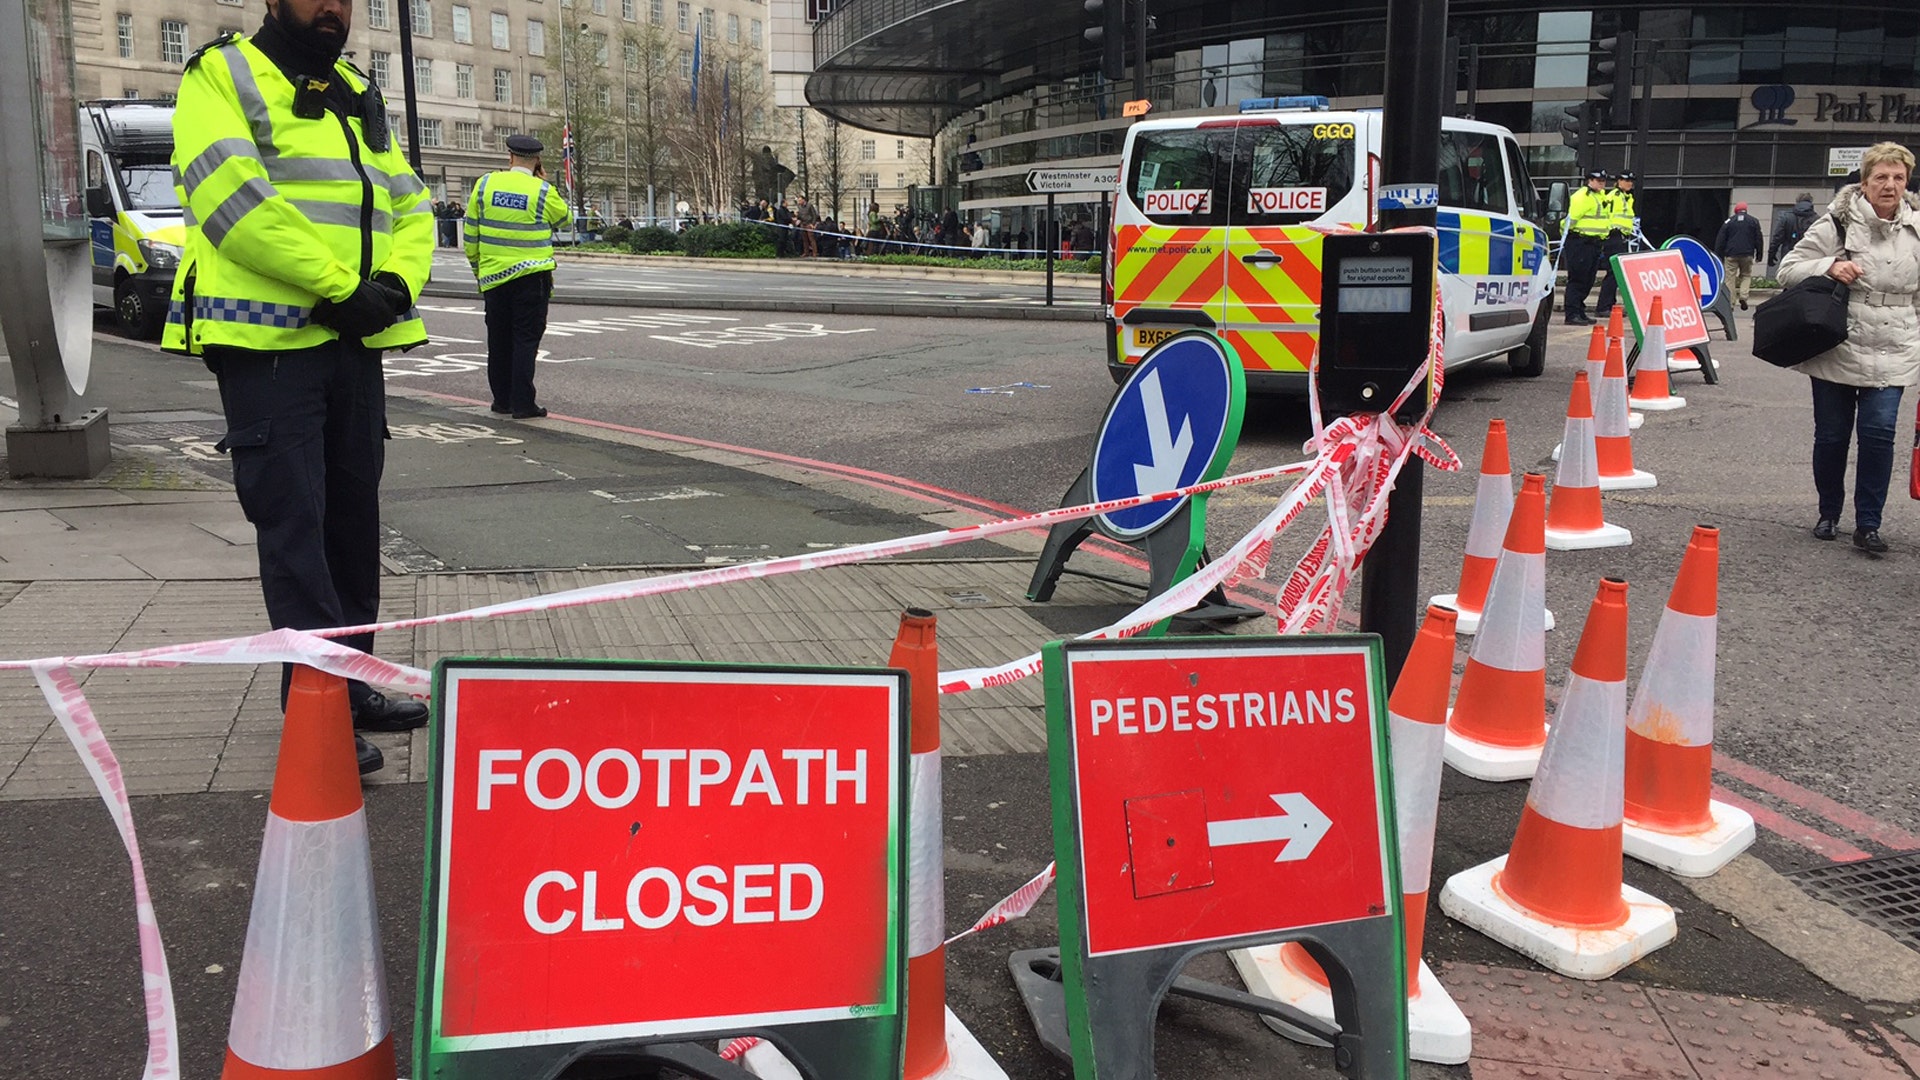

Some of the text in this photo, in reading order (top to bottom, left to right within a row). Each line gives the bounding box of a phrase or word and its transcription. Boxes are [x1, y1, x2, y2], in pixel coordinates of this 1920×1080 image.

[1814, 91, 1876, 122] Park
[1313, 123, 1355, 139] GGQ
[1040, 172, 1092, 180] Westminster
[1040, 180, 1072, 189] Victoria
[494, 196, 526, 209] POLICE
[1147, 192, 1209, 212] POLICE
[1250, 191, 1323, 211] POLICE
[1127, 245, 1212, 255] www.met.police.uk
[1343, 267, 1359, 275] push
[1357, 274, 1377, 282] signal
[1378, 274, 1405, 282] opposite
[1639, 268, 1678, 292] ROAD
[1344, 289, 1409, 311] WAIT
[1647, 305, 1697, 330] OSED
[649, 320, 878, 349] A302
[1090, 688, 1356, 736] PEDESTRIANS
[476, 748, 867, 811] FOOTPATH
[523, 862, 824, 935] CLOSED
